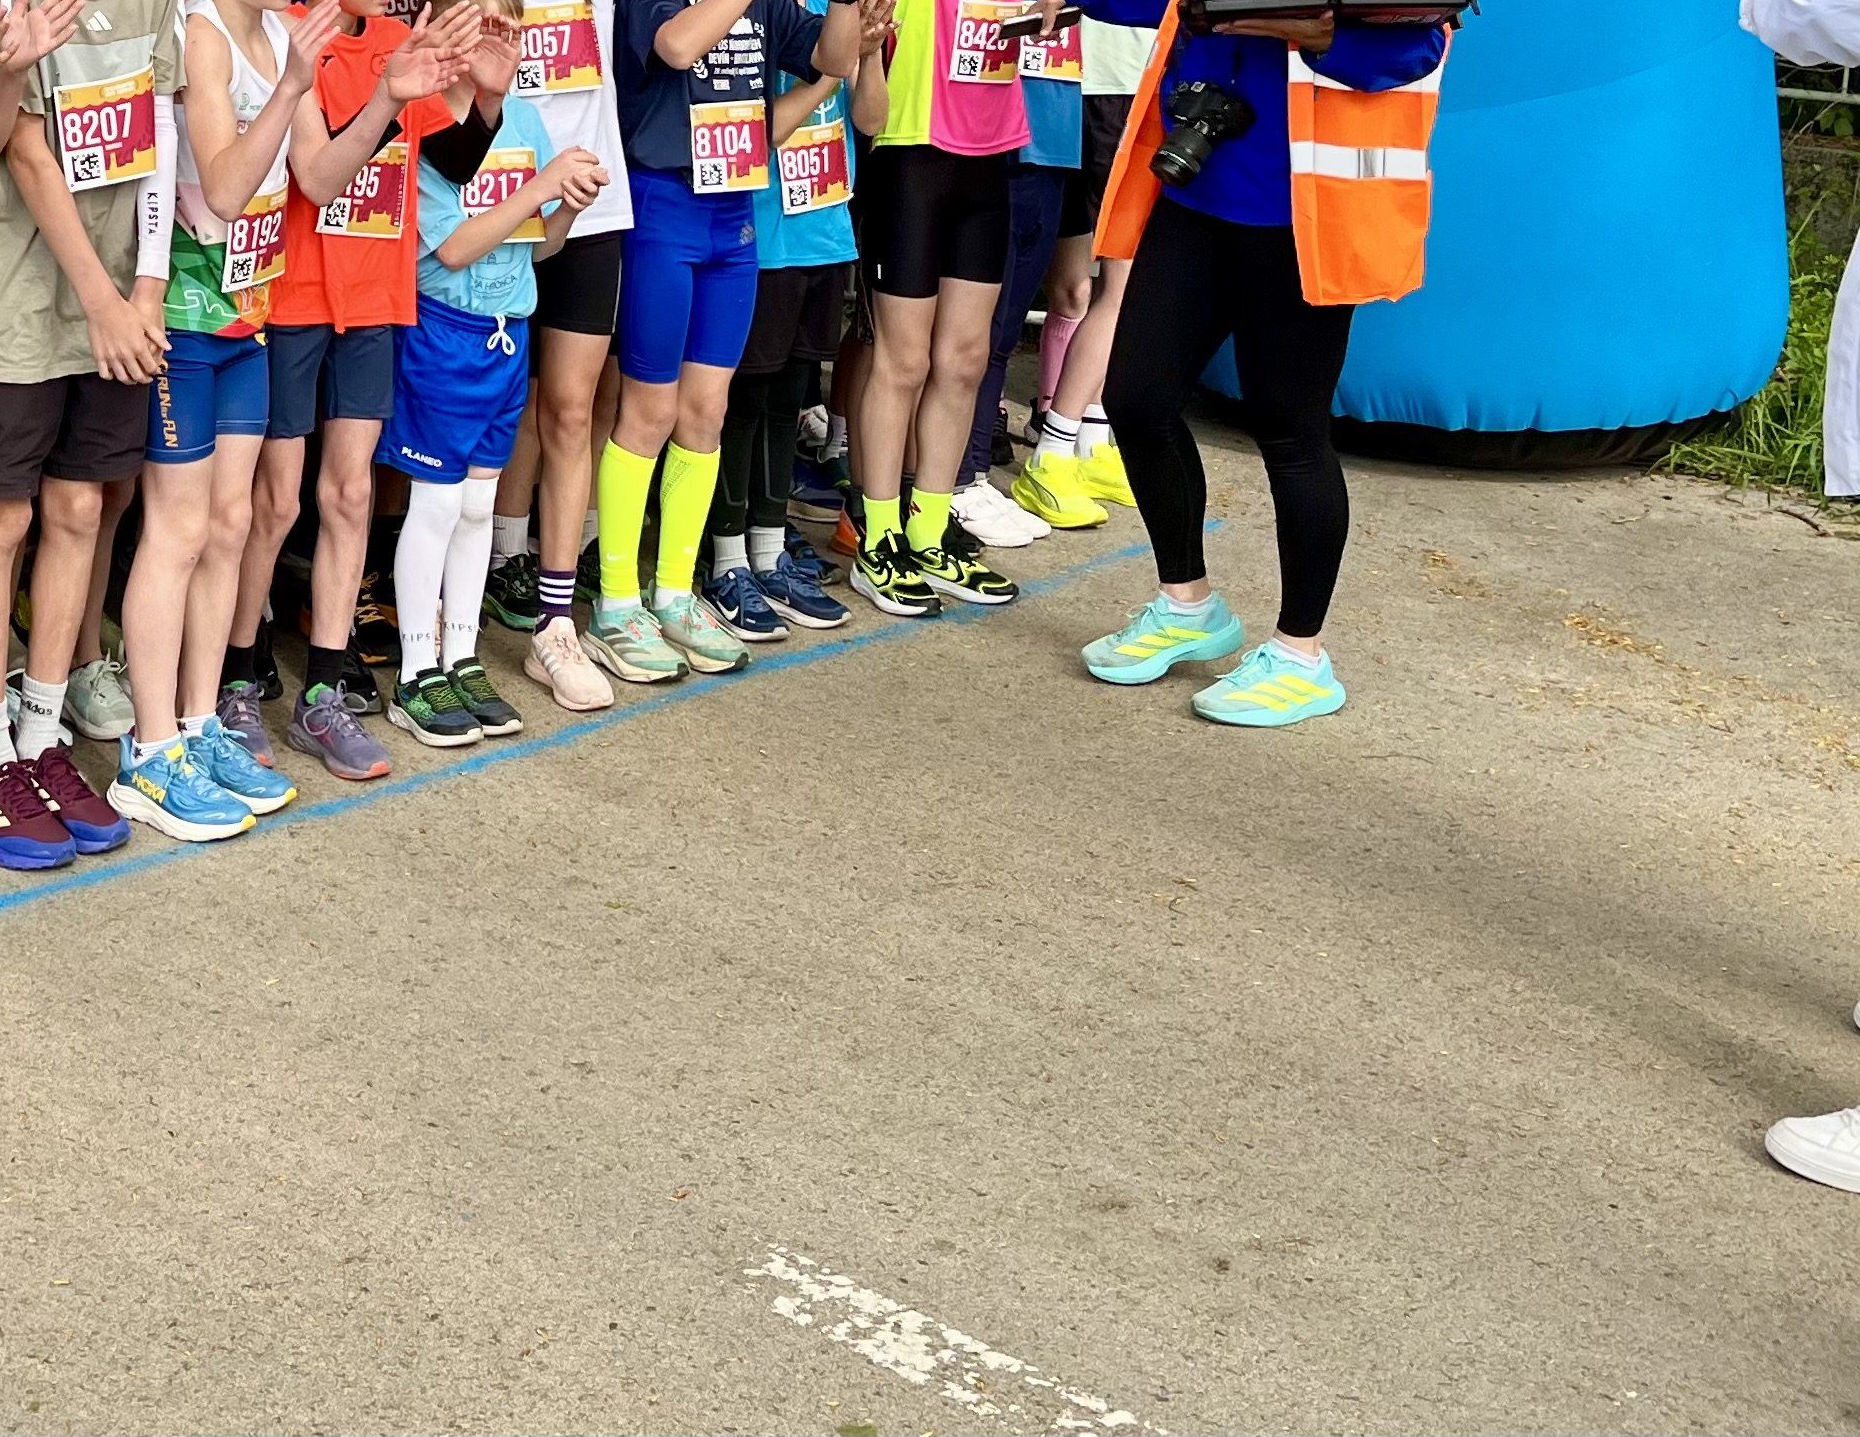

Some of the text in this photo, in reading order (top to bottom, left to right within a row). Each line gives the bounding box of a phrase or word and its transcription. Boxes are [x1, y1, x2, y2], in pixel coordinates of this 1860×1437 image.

[63, 101, 132, 149] 8207
[695, 124, 753, 157] 8104
[782, 145, 830, 181] 8051
[465, 171, 525, 206] 8217
[146, 191, 159, 235] KIPSTA
[232, 210, 282, 253] 8192
